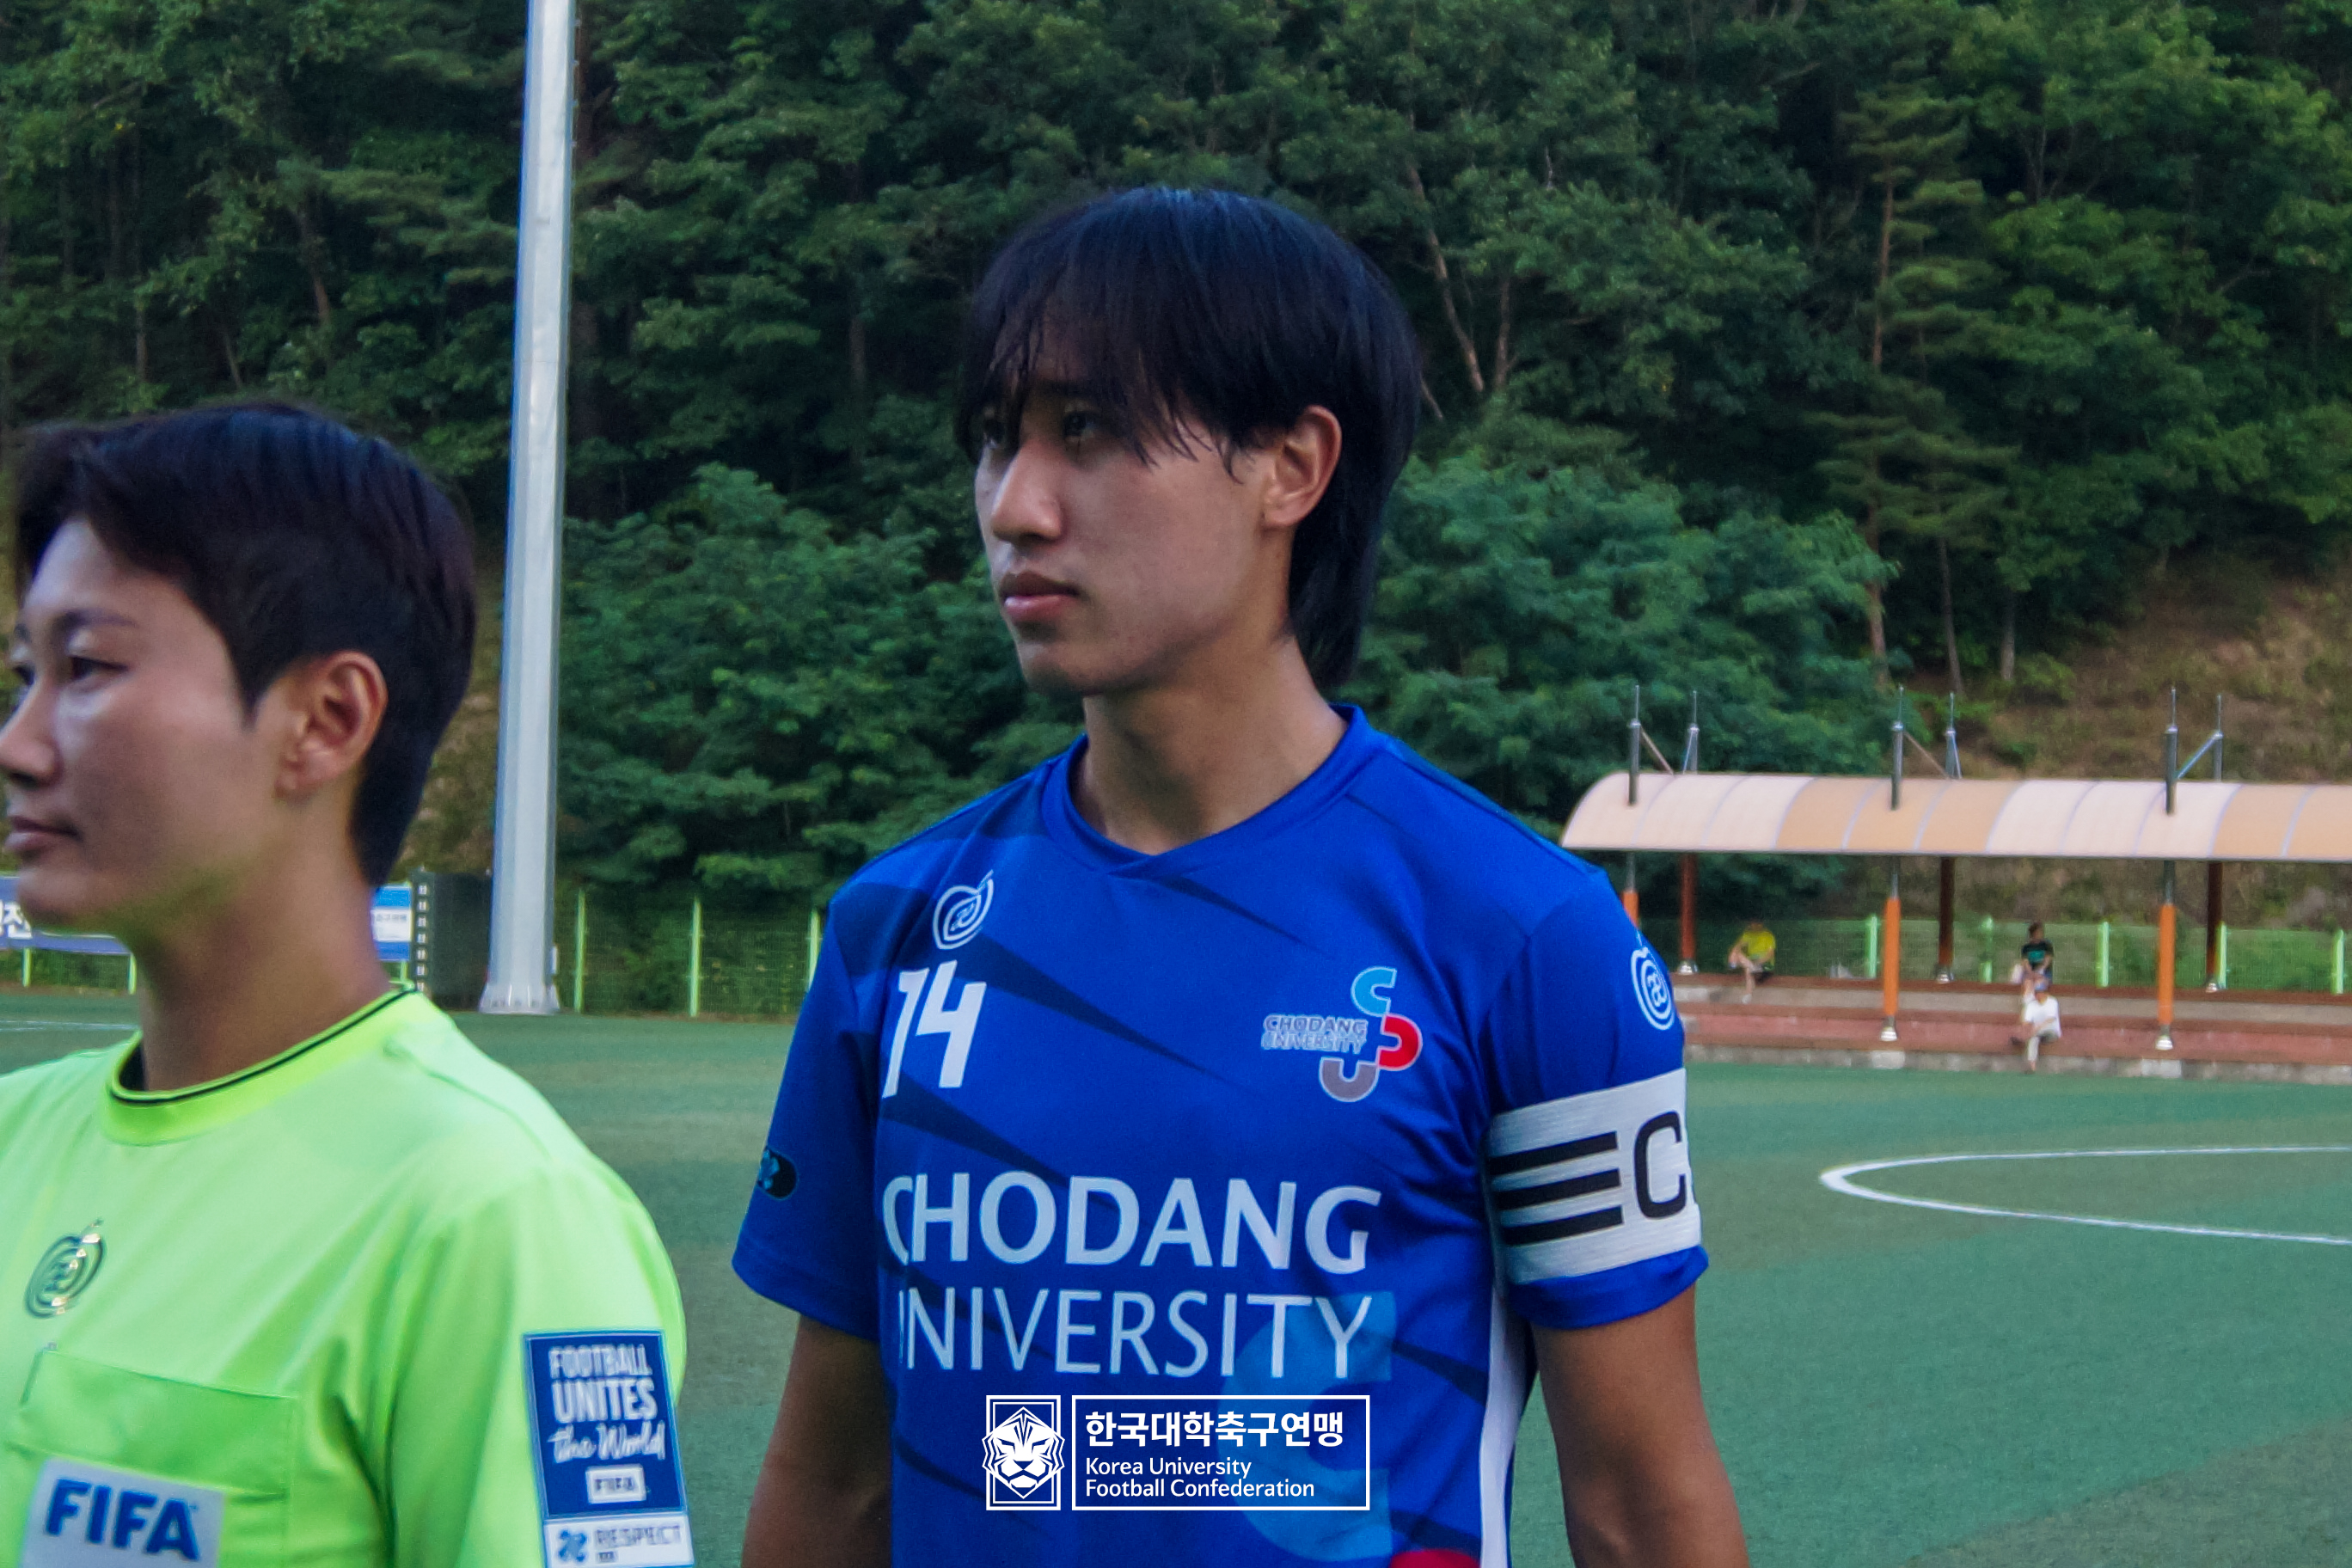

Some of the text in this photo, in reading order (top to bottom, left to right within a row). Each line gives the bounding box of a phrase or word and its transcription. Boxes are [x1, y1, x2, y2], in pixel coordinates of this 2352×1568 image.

[882, 960, 987, 1099] 14
[1263, 1014, 1369, 1035] CHODANG
[1634, 1112, 1687, 1220] C
[882, 1170, 1381, 1275] CHODANG
[548, 1344, 653, 1379] FOOTBALL
[898, 1287, 1373, 1379] NIVERSITY
[551, 1377, 658, 1424] UNITES
[596, 1420, 666, 1461] World
[46, 1478, 200, 1561] FIFA
[595, 1525, 682, 1547] RESPECT
